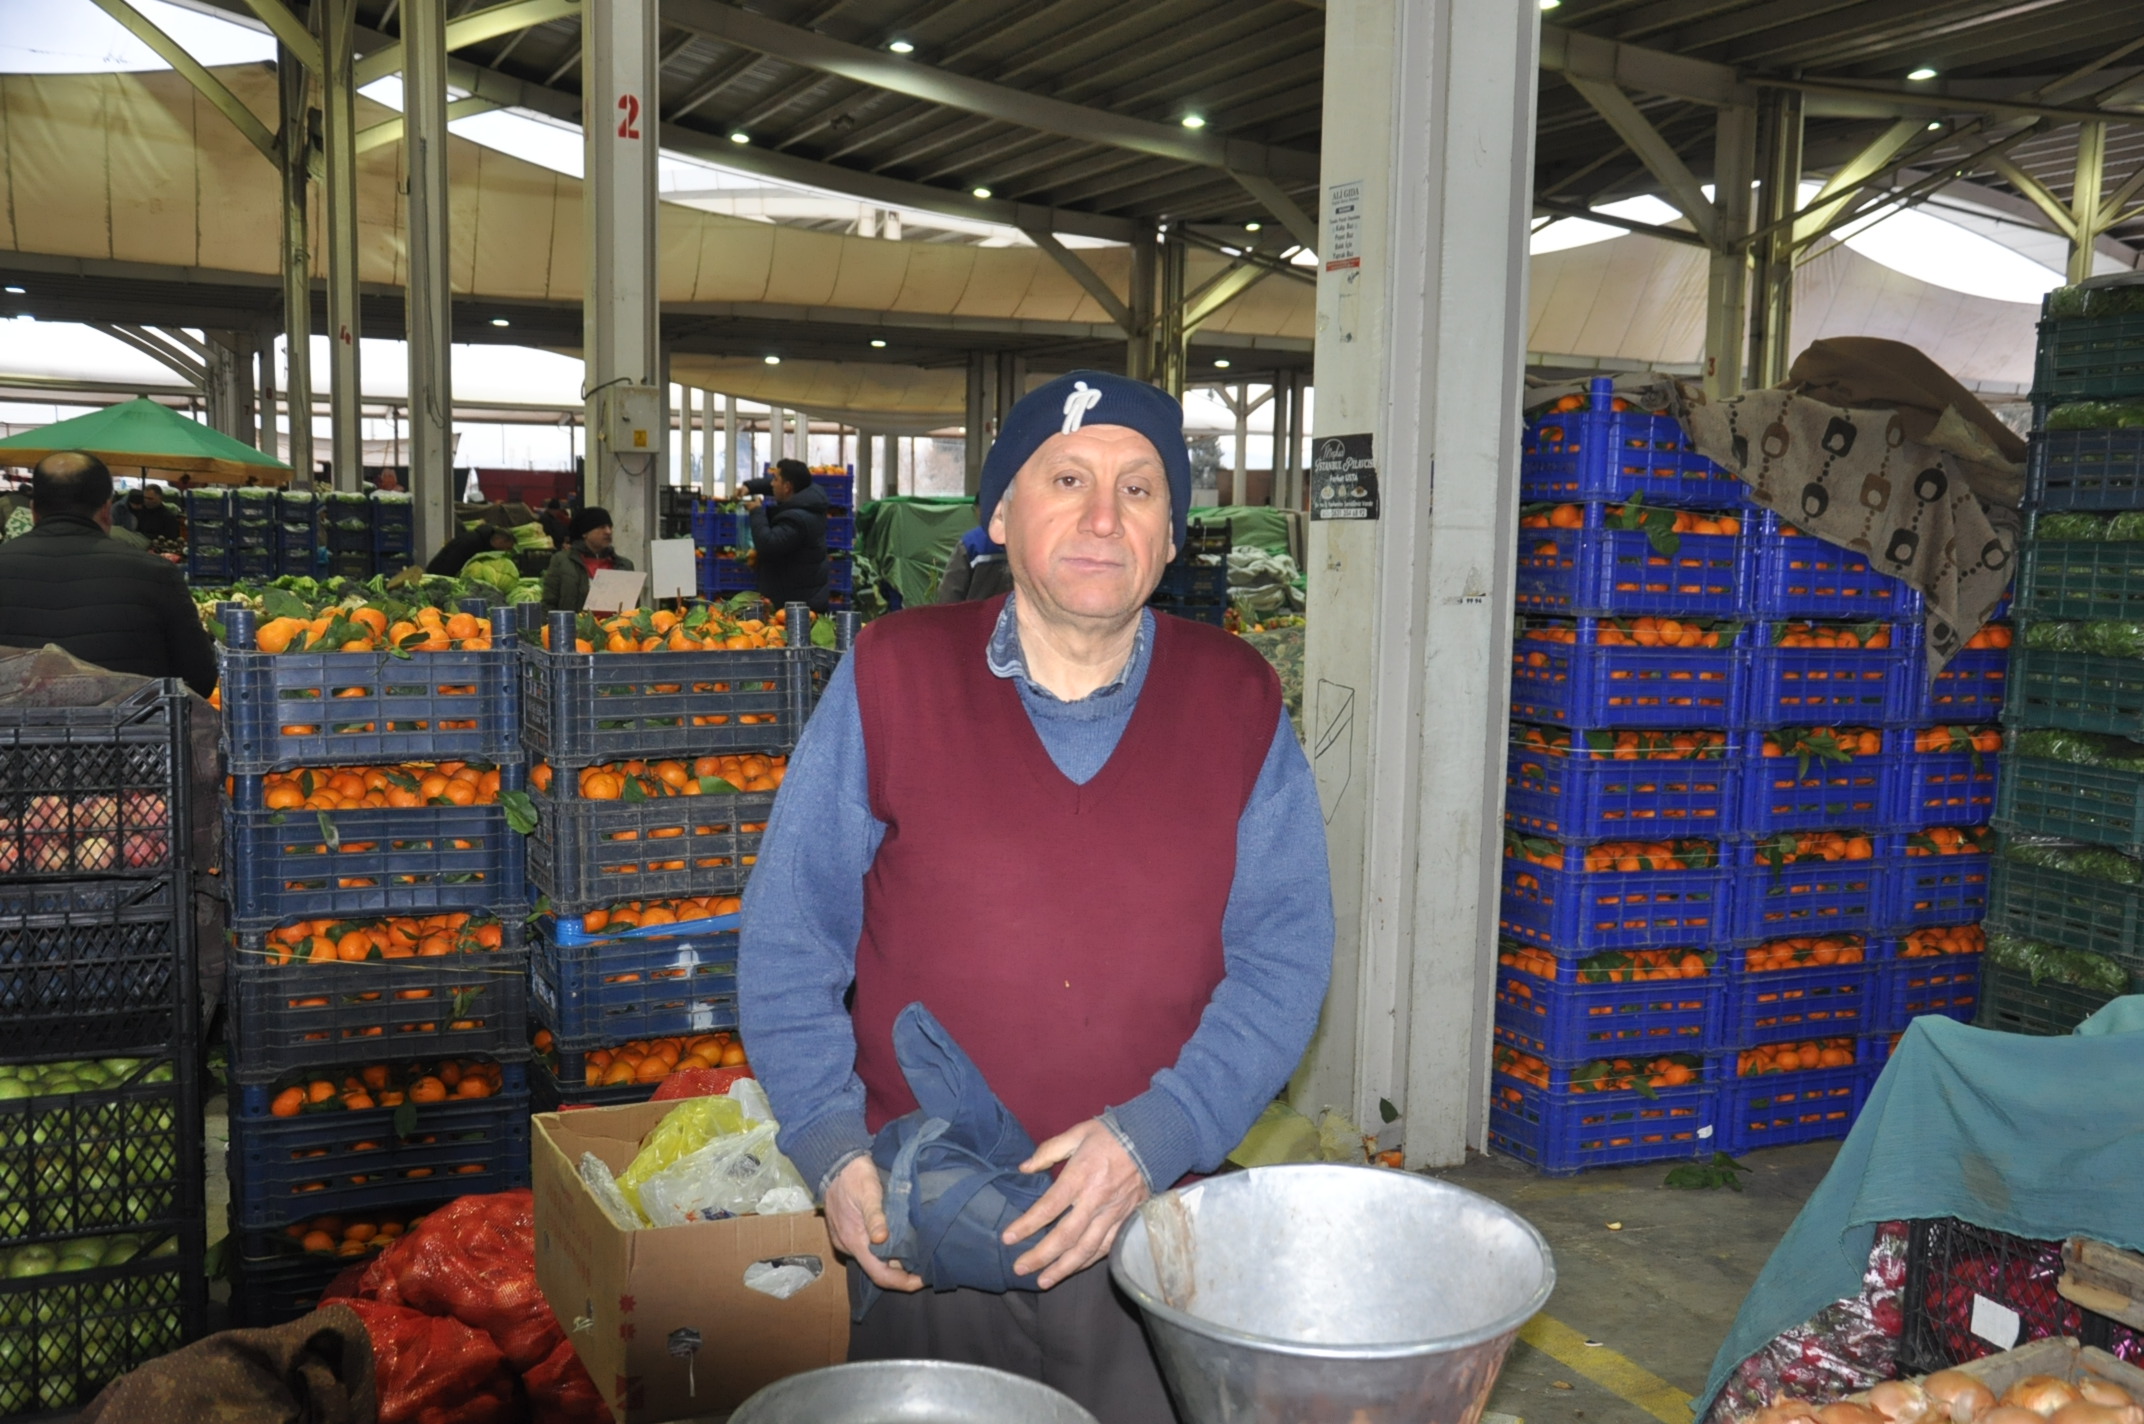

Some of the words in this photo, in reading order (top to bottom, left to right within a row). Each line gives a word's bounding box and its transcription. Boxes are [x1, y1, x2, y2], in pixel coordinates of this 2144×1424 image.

[618, 94, 639, 139] 2
[1343, 187, 1359, 198] GIDA
[1708, 357, 1716, 376] 3
[1345, 473, 1358, 482] USTA
